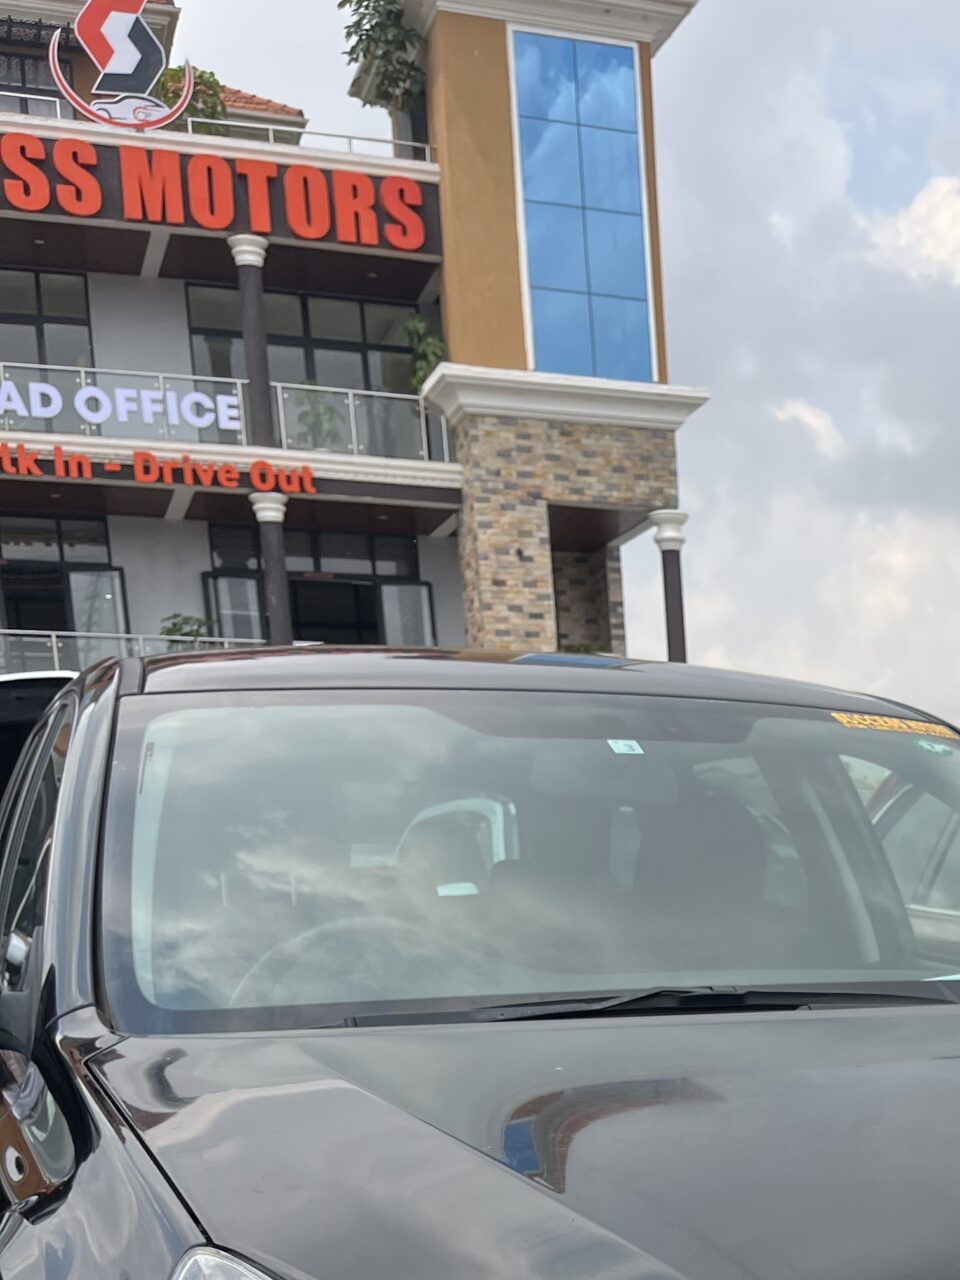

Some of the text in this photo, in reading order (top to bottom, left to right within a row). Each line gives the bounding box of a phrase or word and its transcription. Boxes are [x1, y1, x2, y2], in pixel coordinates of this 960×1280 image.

[1, 132, 426, 251] SS MOTORS
[0, 380, 242, 431] AD OFFICE
[54, 445, 93, 480] In
[132, 450, 240, 488] Drive
[250, 459, 316, 494] Out
